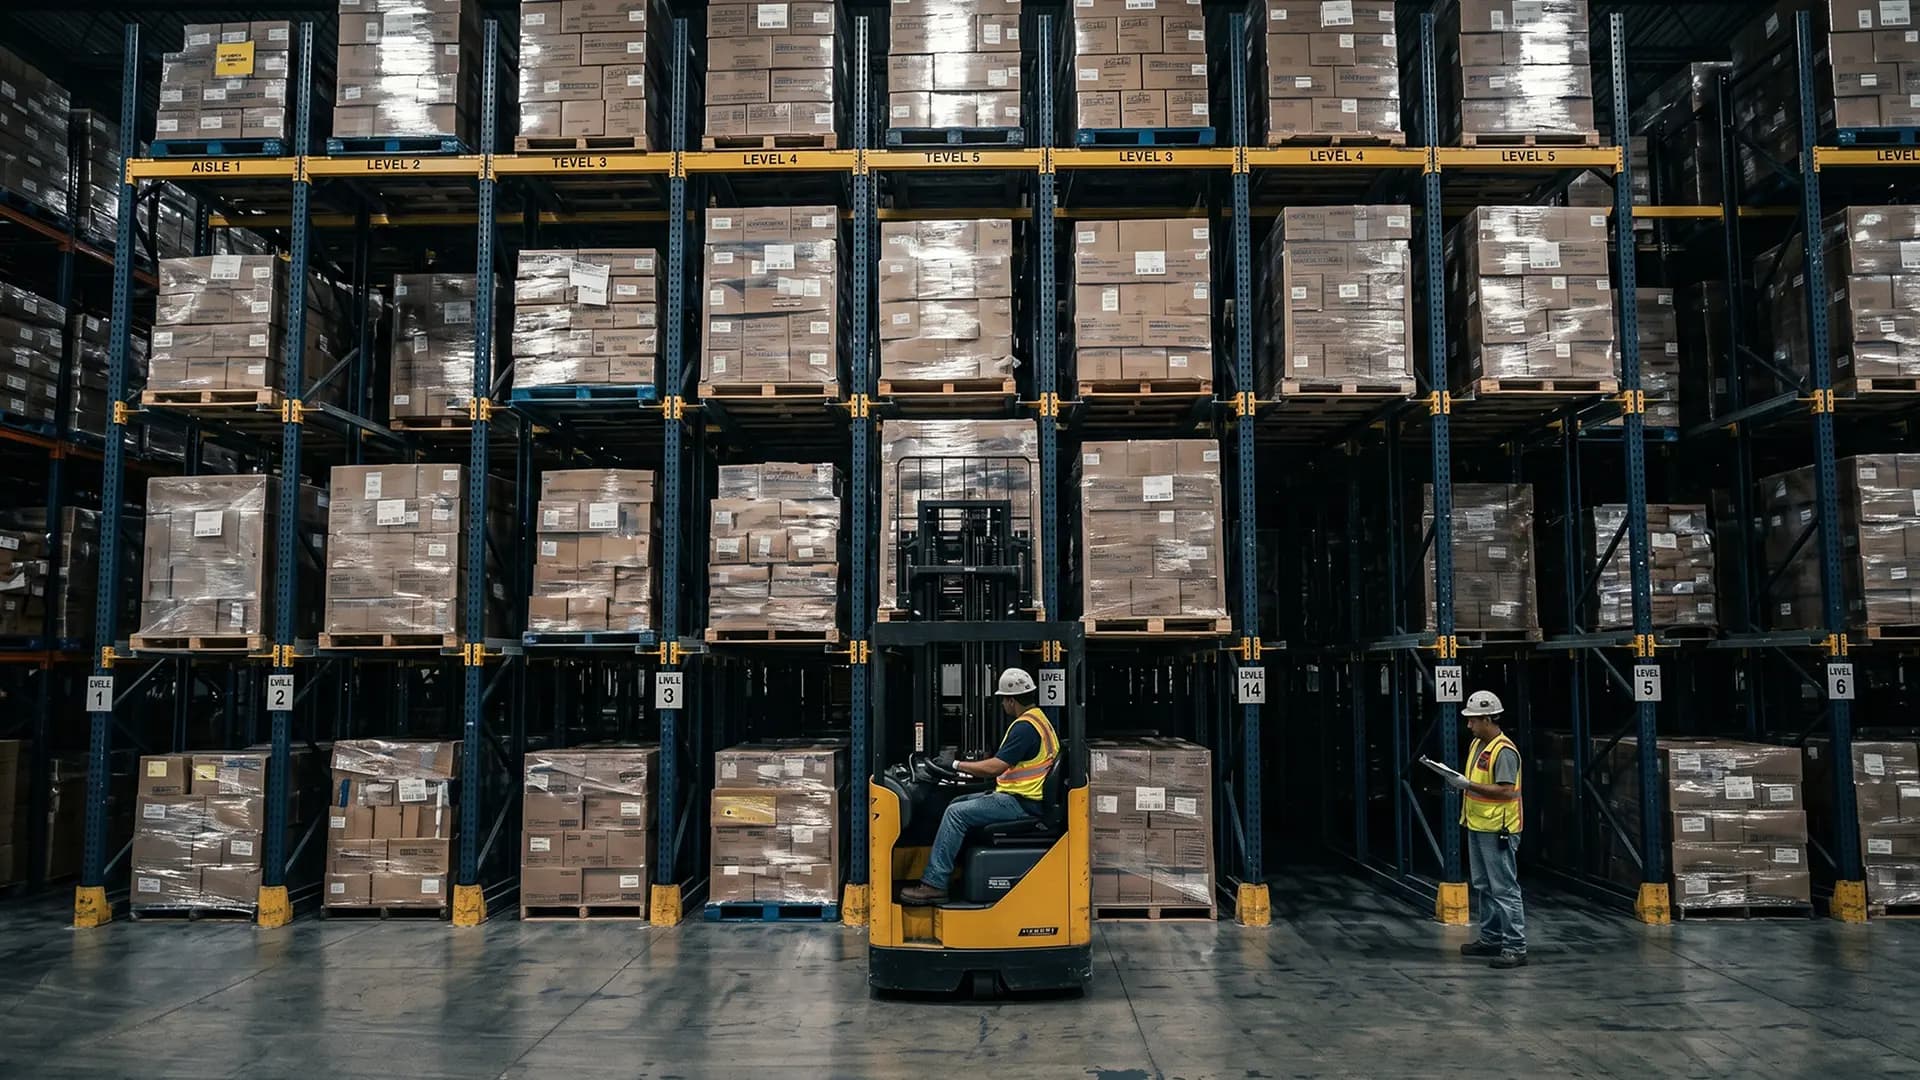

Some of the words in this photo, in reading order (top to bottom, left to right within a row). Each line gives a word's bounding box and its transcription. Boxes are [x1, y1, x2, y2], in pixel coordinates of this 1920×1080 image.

[743, 154, 785, 165] LEVEL
[789, 154, 798, 164] 4
[925, 152, 968, 163] TEVEL
[972, 152, 980, 163] 5
[1119, 152, 1161, 162] LEVEL
[1165, 151, 1173, 162] 3
[1310, 150, 1352, 161] LEVEL
[1356, 150, 1363, 161] 4
[1502, 151, 1543, 161] LEVEL
[1548, 151, 1555, 161] 5
[1877, 150, 1920, 160] LEVEL
[191, 161, 230, 172] AISLE
[234, 161, 240, 172] 1
[367, 159, 408, 170] LEVEL
[412, 159, 420, 170] 2
[552, 157, 594, 168] TEVEL
[599, 157, 607, 167] 3
[1243, 682, 1261, 698] 14
[1440, 681, 1458, 697] 14
[1644, 681, 1653, 695] 5
[1836, 679, 1846, 694] 6
[275, 690, 284, 705] 2
[664, 688, 674, 703] 3
[1047, 685, 1057, 700] 5
[96, 691, 102, 706] 1
